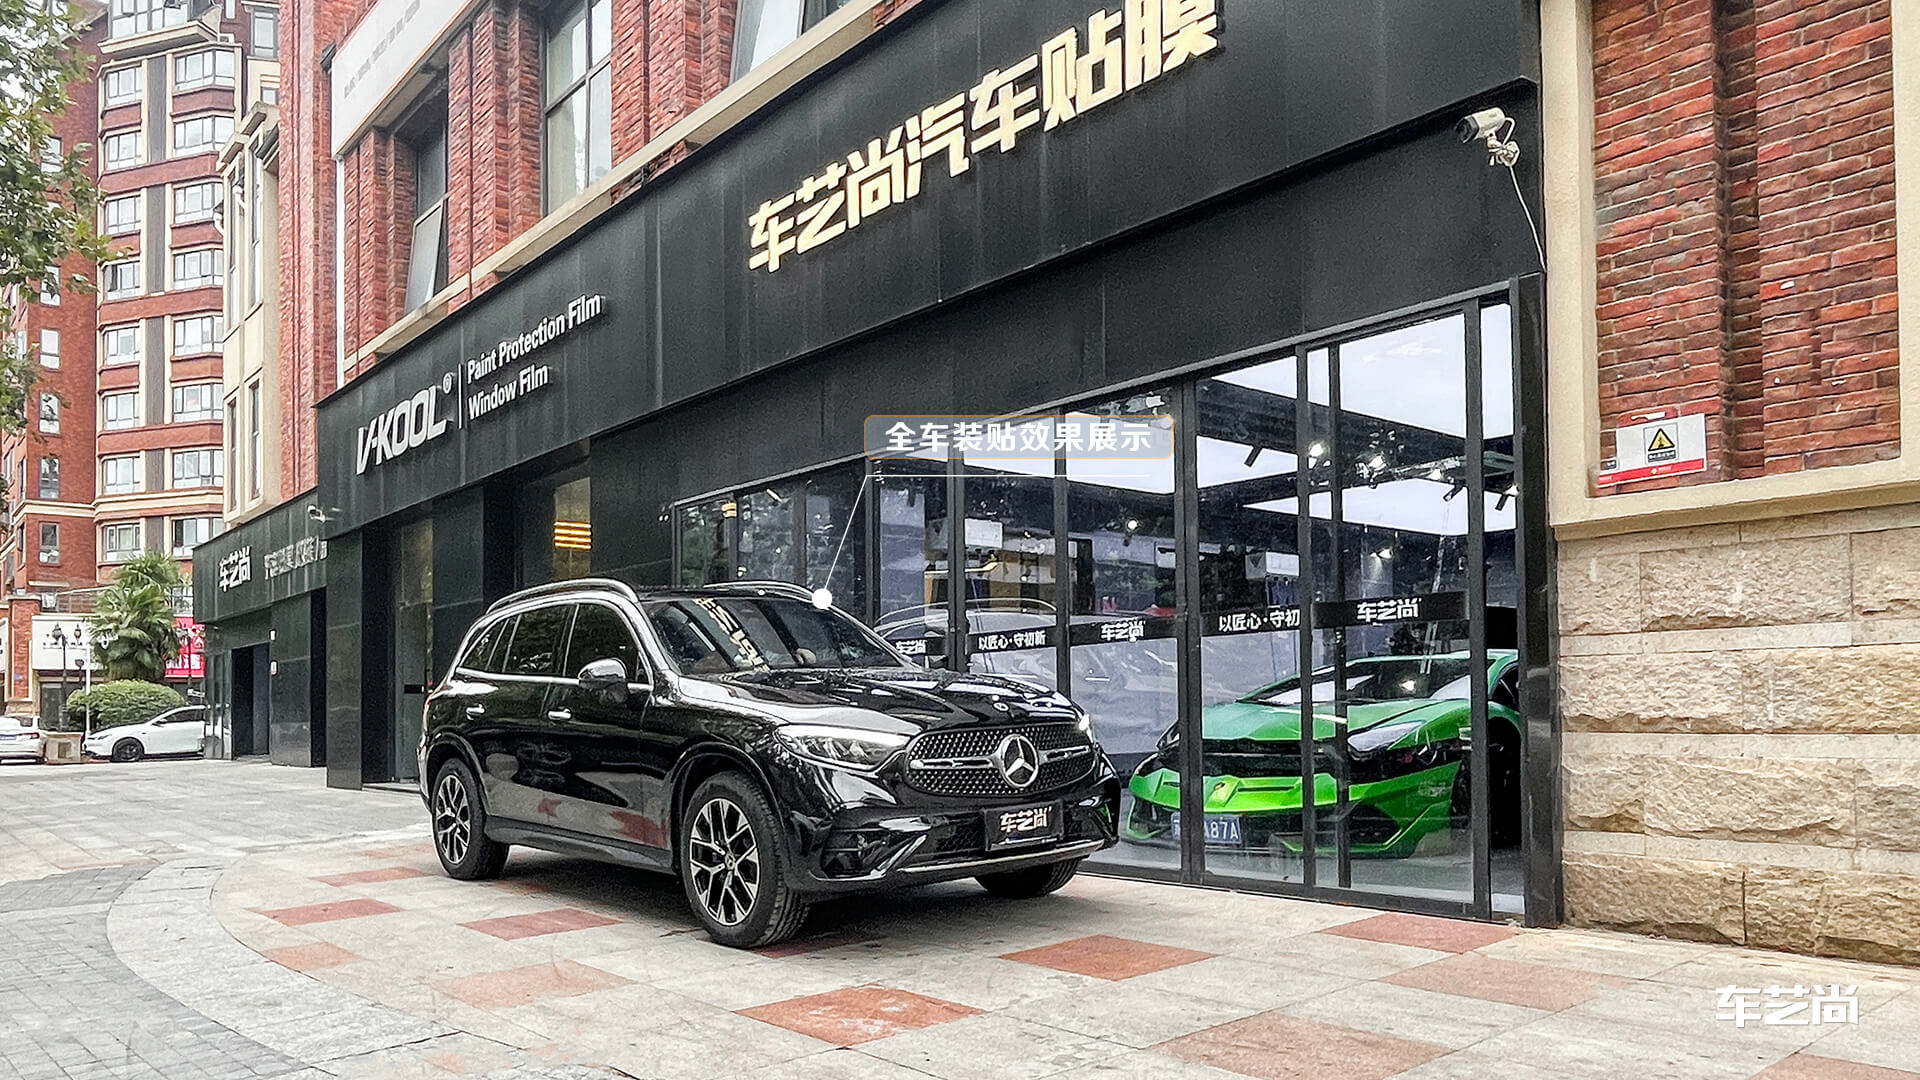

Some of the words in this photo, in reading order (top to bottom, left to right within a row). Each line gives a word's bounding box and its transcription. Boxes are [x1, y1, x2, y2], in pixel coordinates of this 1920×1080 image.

[748, 0, 1218, 273] 车艺尚汽车贴膜
[467, 349, 497, 384] Paint
[499, 313, 565, 365] Protection
[568, 294, 601, 330] Film
[468, 379, 516, 420] Window
[519, 363, 549, 397] Film
[219, 545, 251, 593] 车艺尚
[1101, 617, 1146, 642] 车艺尚
[1357, 598, 1421, 623] 车艺尚
[1000, 806, 1052, 833] 车艺尚
